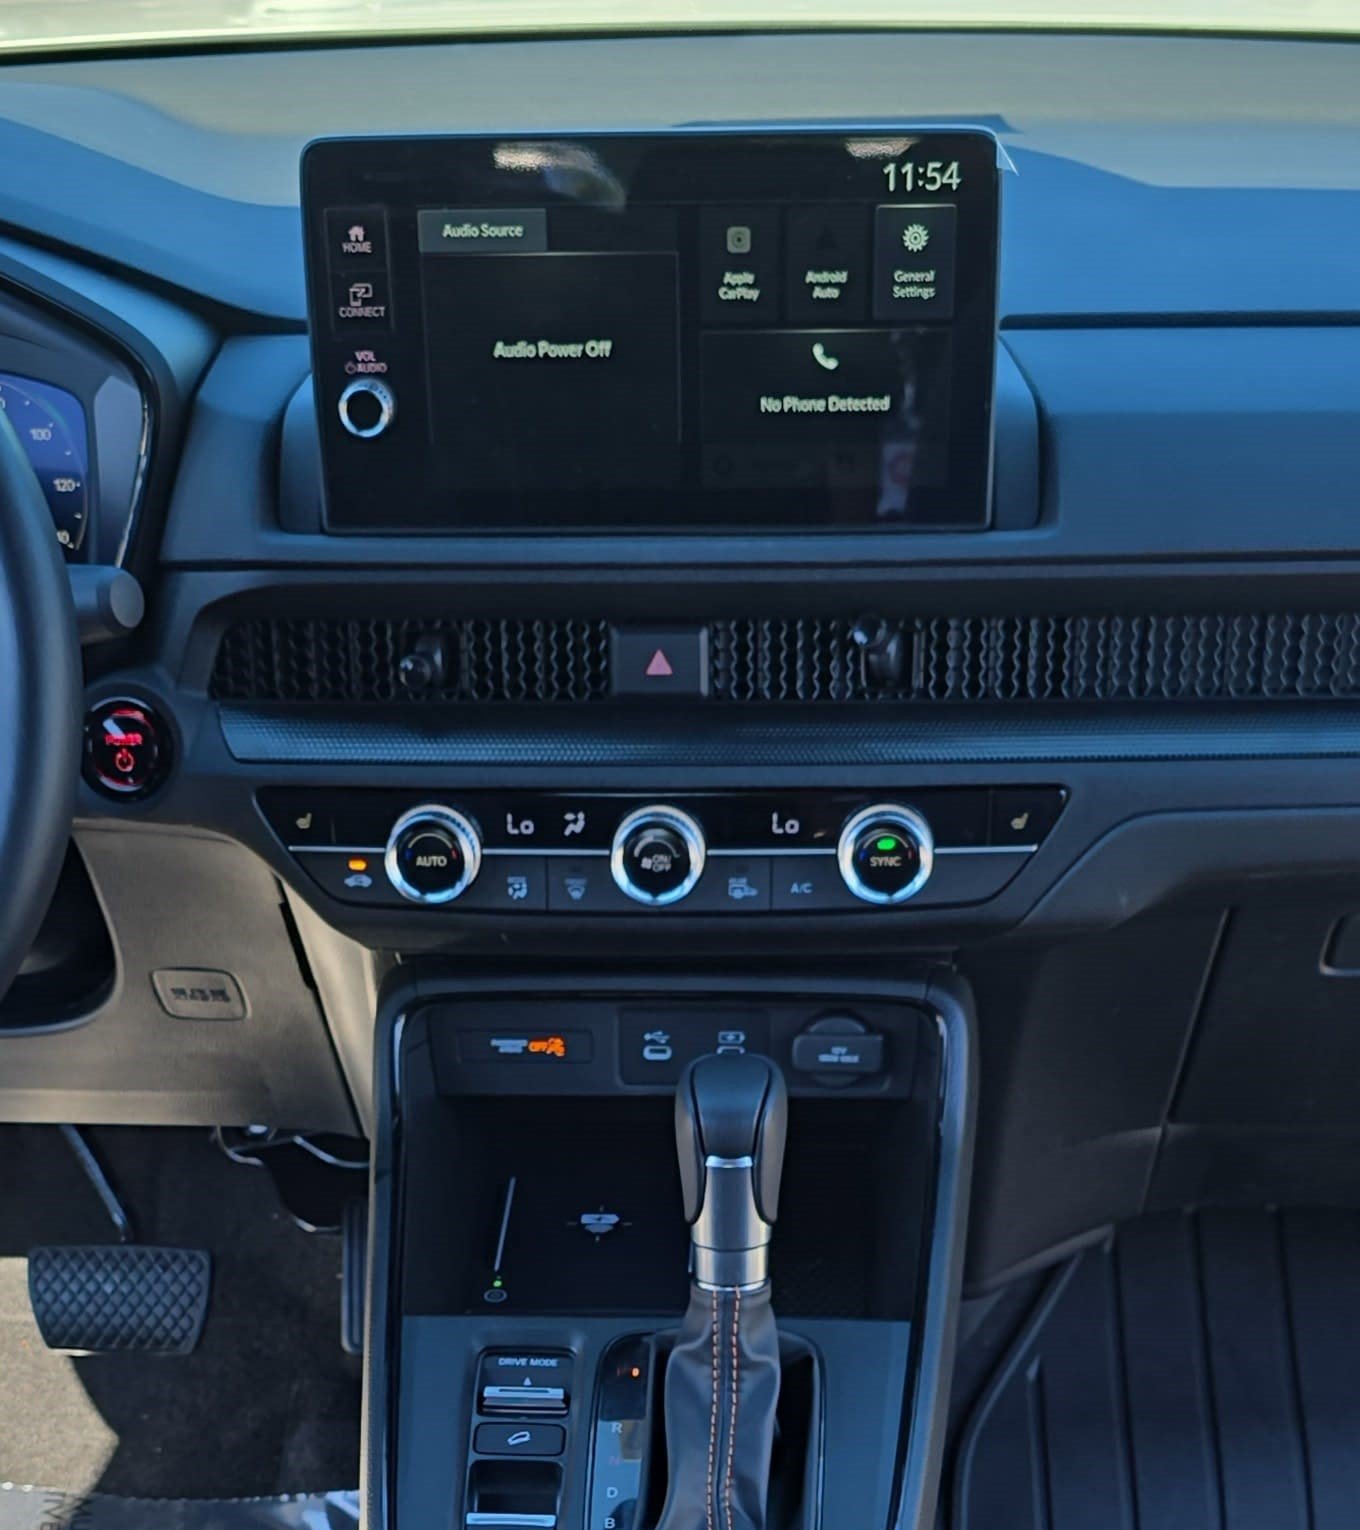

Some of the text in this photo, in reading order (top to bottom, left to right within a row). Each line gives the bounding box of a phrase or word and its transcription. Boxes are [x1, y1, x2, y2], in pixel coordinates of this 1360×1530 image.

[883, 161, 961, 192] 11:54
[442, 223, 524, 238] Audio Source
[343, 241, 372, 253] HOME
[723, 270, 755, 287] Apple
[805, 269, 848, 284] Android
[893, 269, 935, 283] General
[718, 285, 761, 302] CarPlay
[812, 285, 840, 300] Auto
[892, 285, 936, 301] Settings
[339, 306, 385, 318] CONNECT
[354, 350, 377, 362] VOL
[493, 340, 612, 359] Audio Power Off
[357, 362, 388, 373] AUDIO
[760, 394, 890, 413] No Phone Detected
[53, 479, 76, 493] 120
[506, 812, 534, 835] Lo
[771, 812, 799, 834] Lo
[415, 855, 448, 868] AUTO
[870, 856, 902, 867] SYNC
[790, 882, 813, 894] A/C
[498, 1357, 558, 1367] DRIVE MODE
[611, 1422, 623, 1434] R
[606, 1487, 618, 1498] D
[604, 1517, 616, 1529] B
